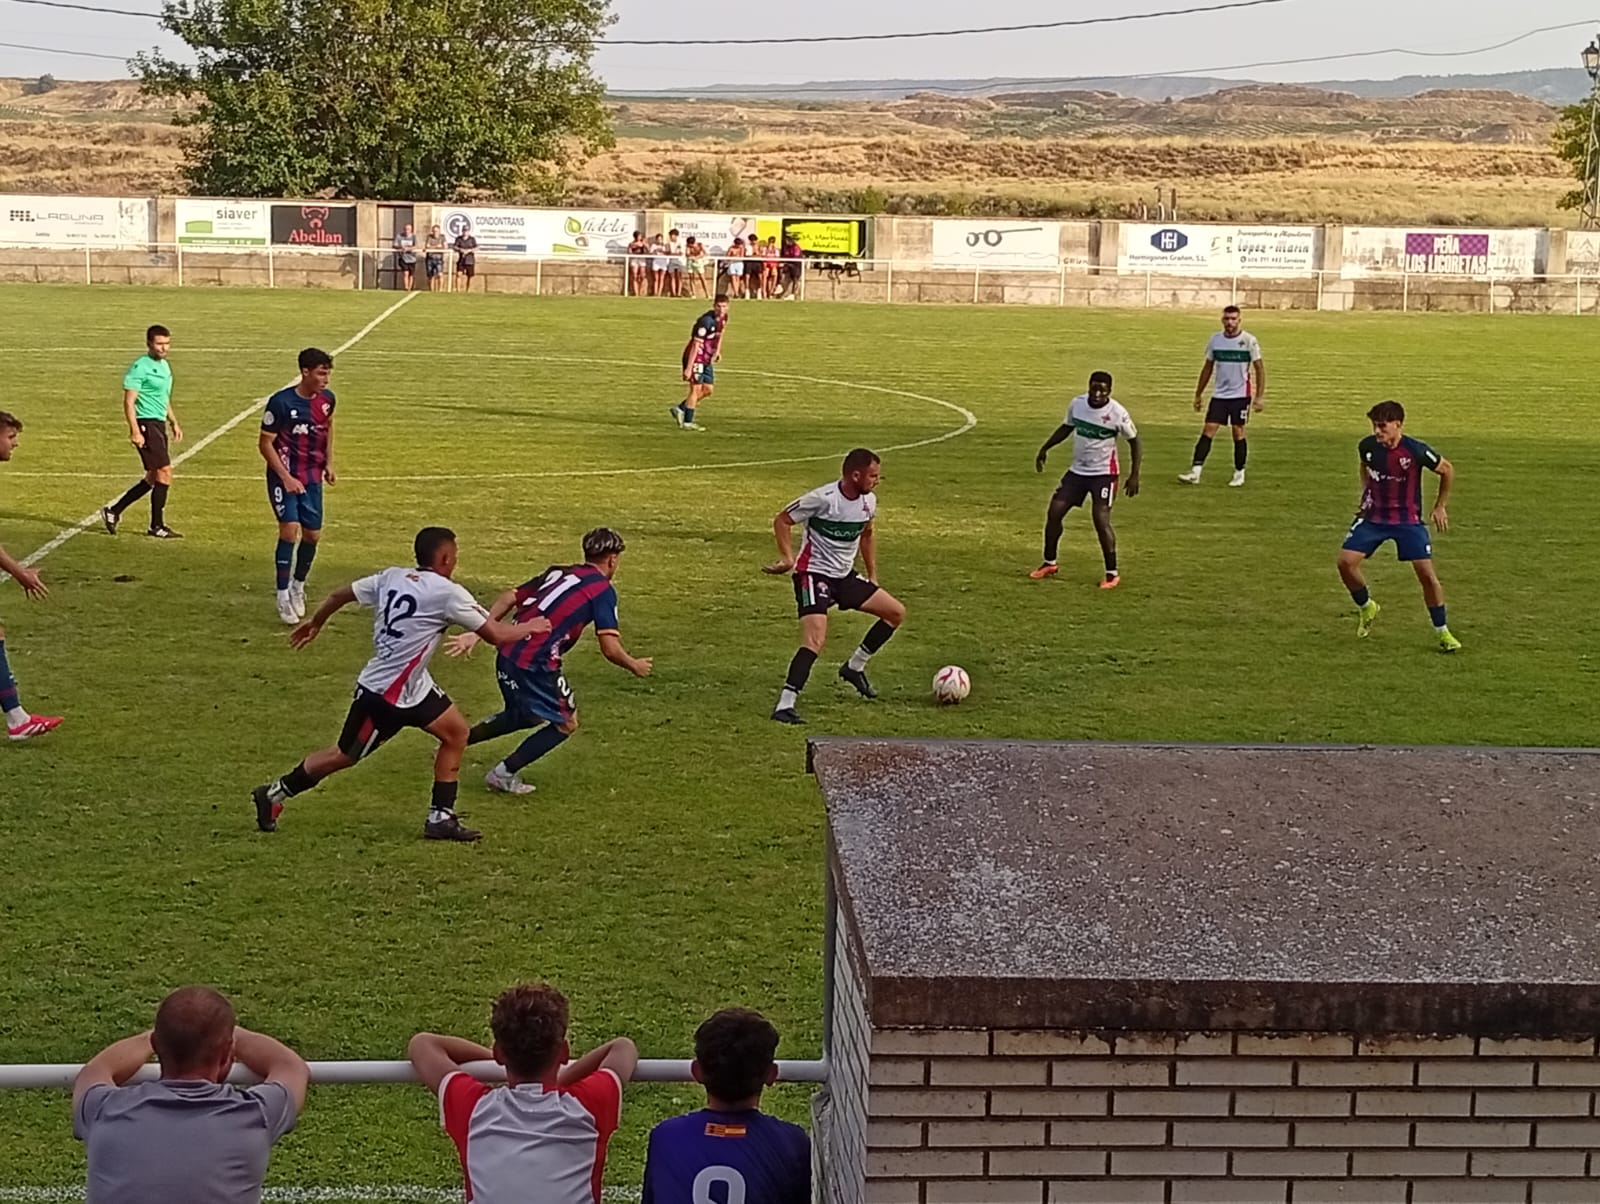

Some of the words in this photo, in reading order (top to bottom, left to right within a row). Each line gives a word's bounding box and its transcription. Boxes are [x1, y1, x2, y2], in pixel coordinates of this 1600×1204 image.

[36, 212, 104, 221] LAGUNA
[216, 207, 257, 219] siaver
[475, 216, 525, 226] CONDONTRANS
[288, 228, 342, 243] Abellan
[1433, 234, 1460, 254] PEÑA
[1405, 254, 1426, 273] LOS
[1428, 254, 1487, 274] LICORETAS
[274, 486, 283, 502] 9
[1101, 487, 1109, 499] 6
[381, 589, 417, 638] 12
